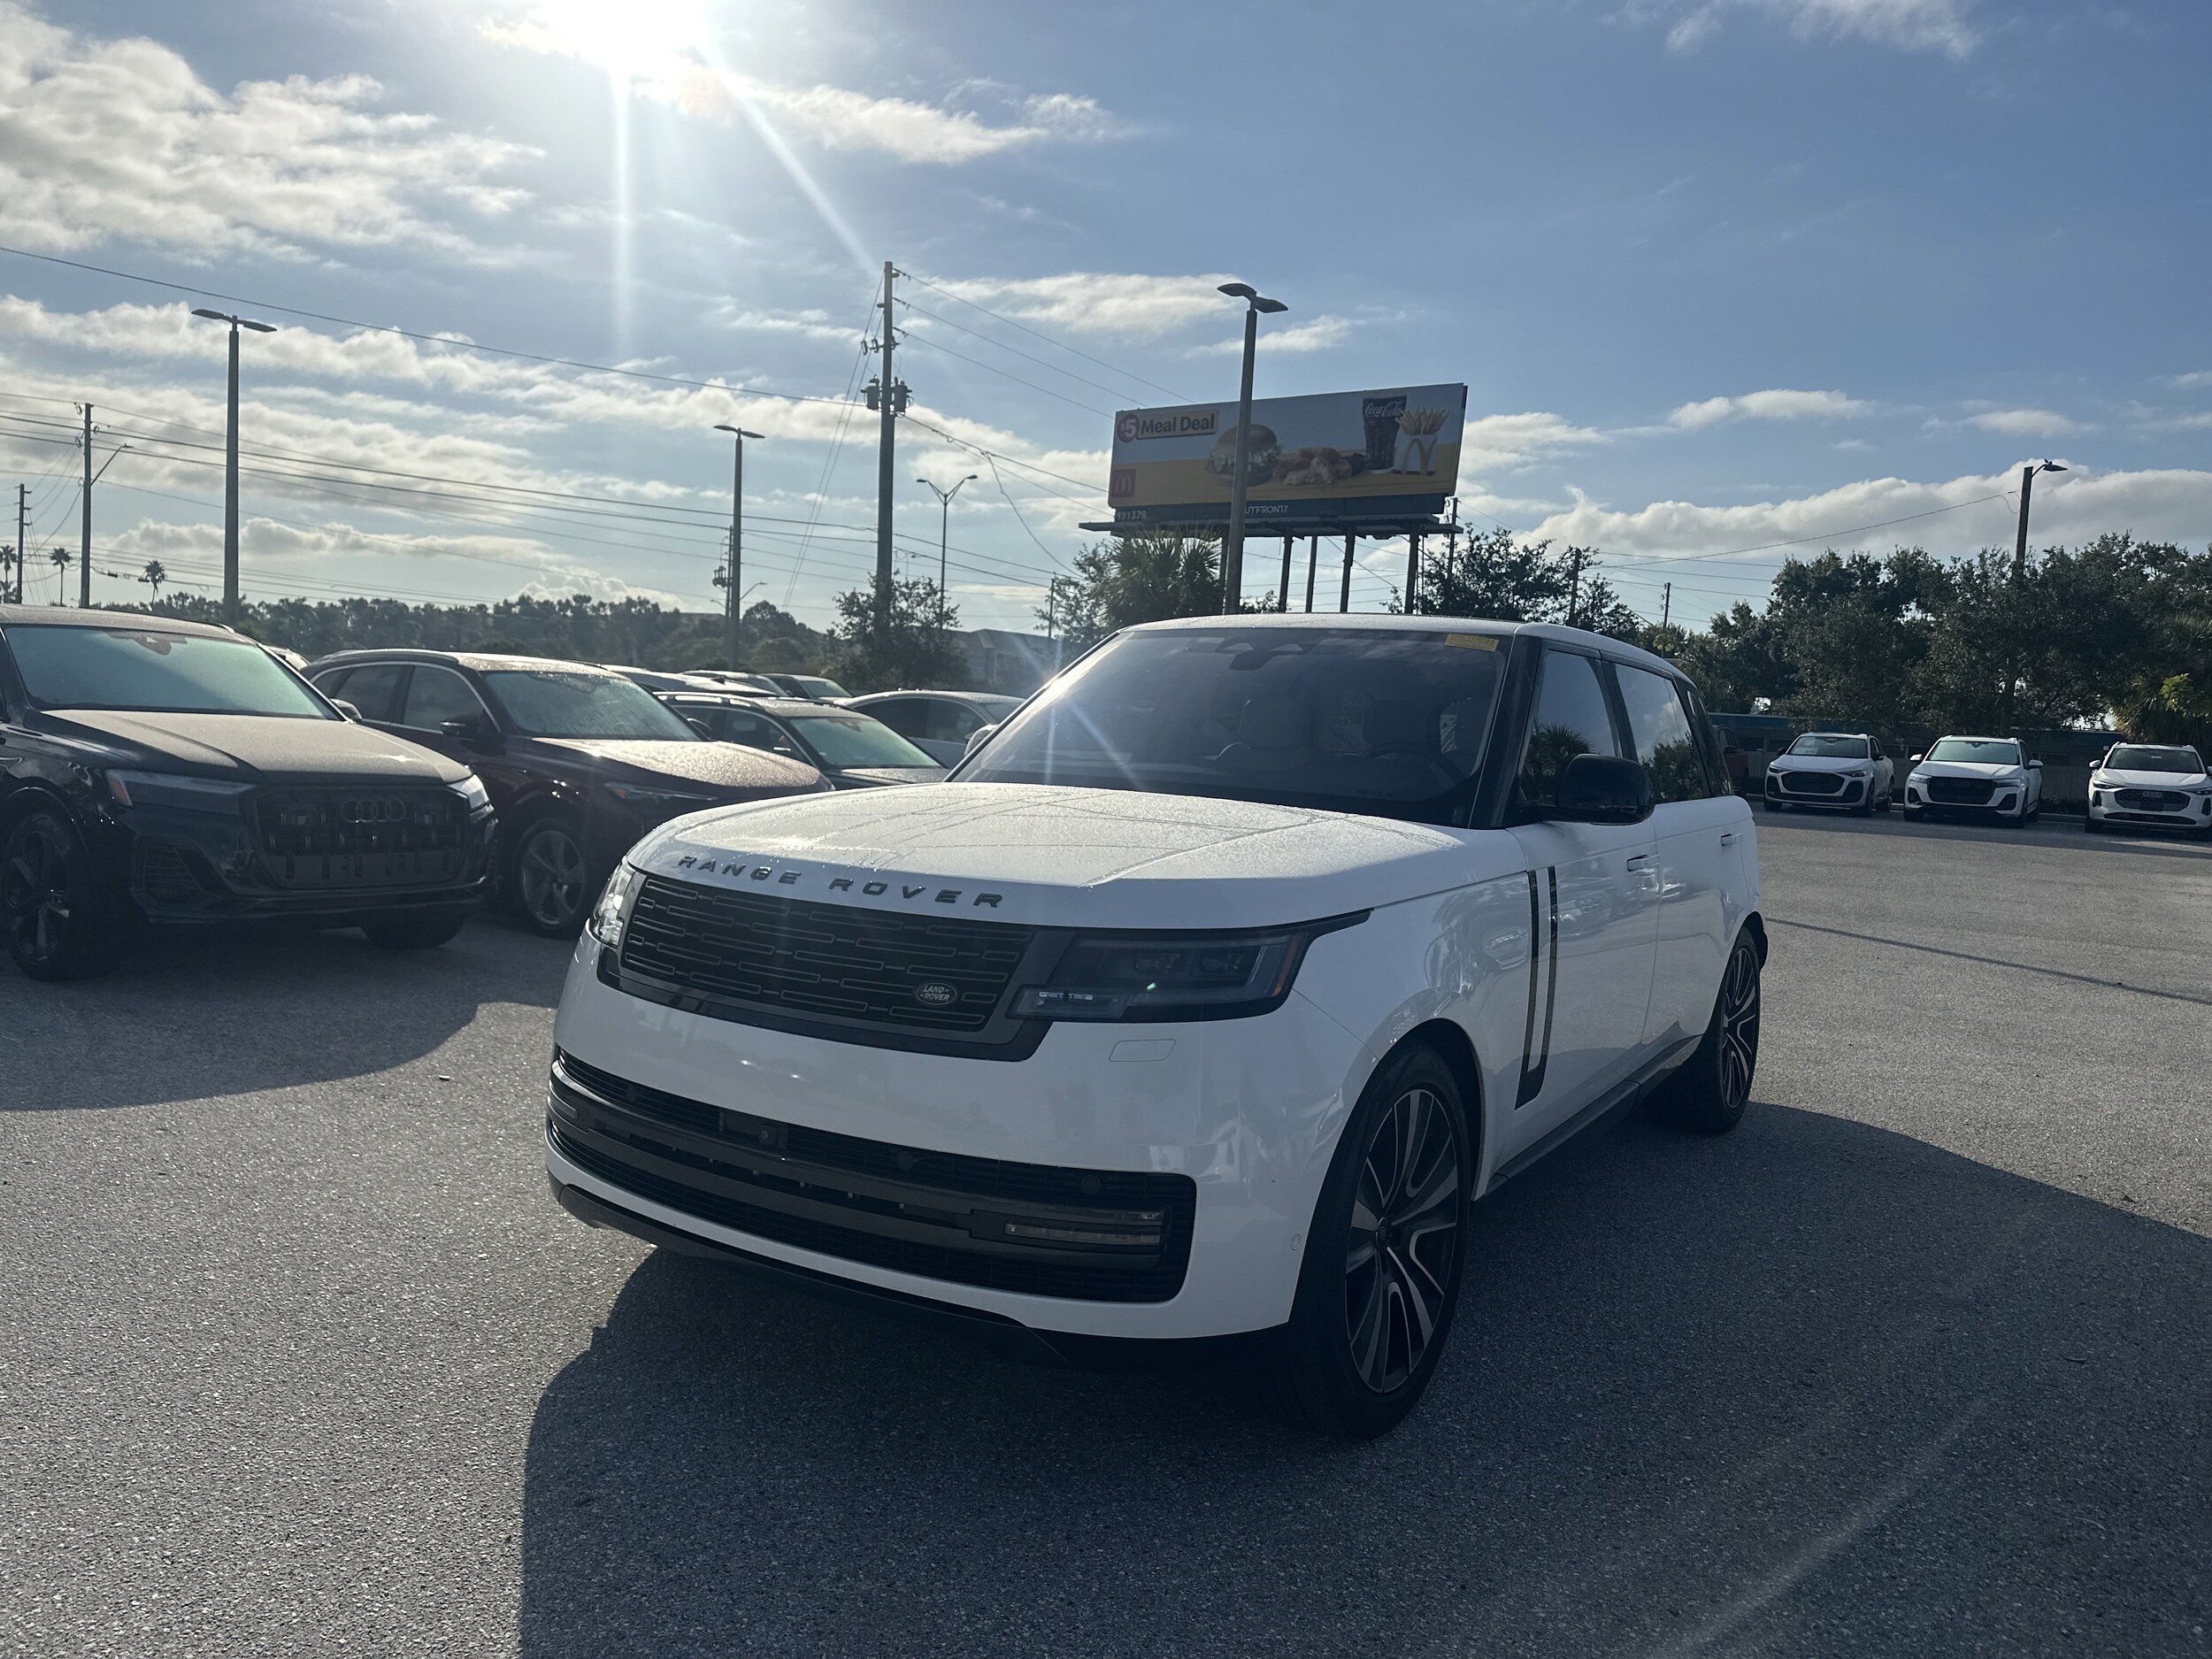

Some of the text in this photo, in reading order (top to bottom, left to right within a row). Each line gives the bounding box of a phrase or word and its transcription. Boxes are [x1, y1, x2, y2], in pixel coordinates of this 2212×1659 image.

[1141, 416, 1177, 434] Meal
[1180, 413, 1215, 431] Deal
[678, 856, 1002, 908] RANGE ROVER
